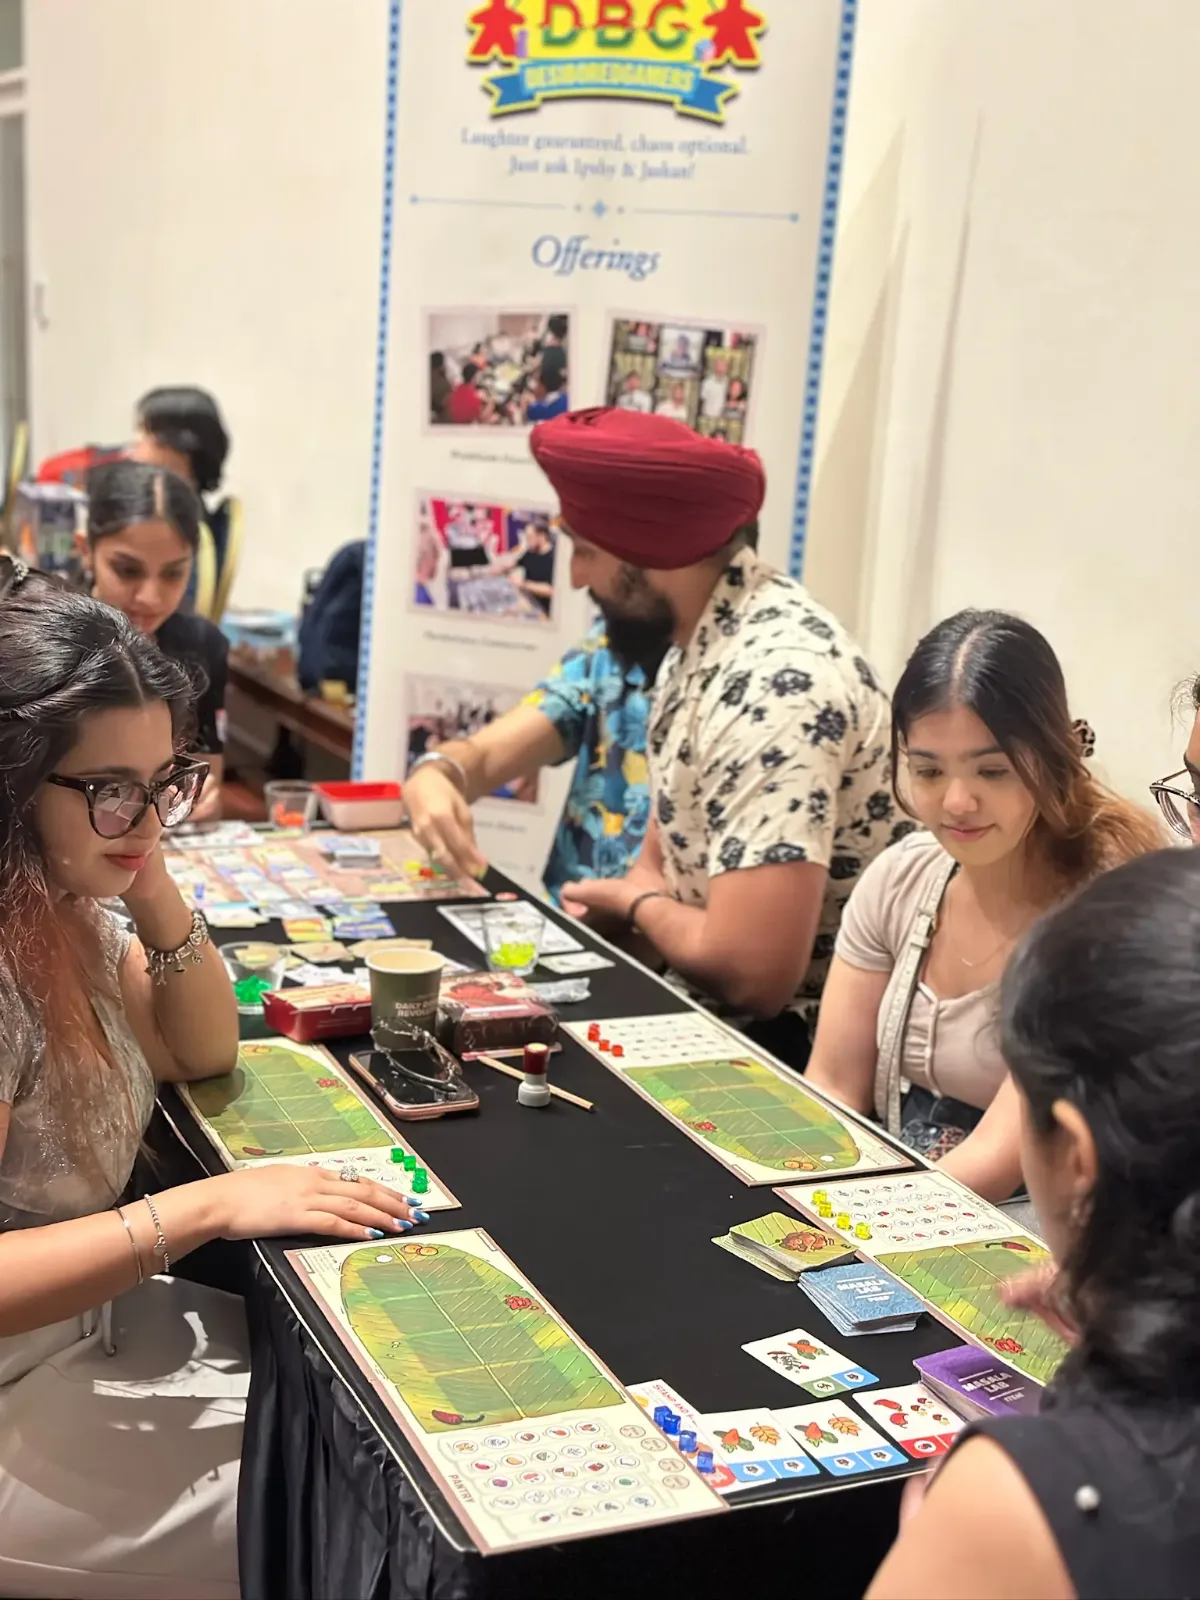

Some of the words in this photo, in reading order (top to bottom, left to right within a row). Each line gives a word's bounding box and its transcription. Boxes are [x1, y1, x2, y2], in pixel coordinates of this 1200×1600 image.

[539, 0, 692, 49] DBG
[545, 156, 568, 173] ask
[532, 234, 661, 282] Offerings
[836, 1279, 889, 1291] MASALA
[856, 1285, 882, 1294] LAB
[961, 1372, 1012, 1392] MASALA
[983, 1381, 1010, 1393] LAB
[654, 1384, 677, 1403] STAMP
[674, 1402, 689, 1415] AND
[448, 1474, 476, 1503] PANTRY
